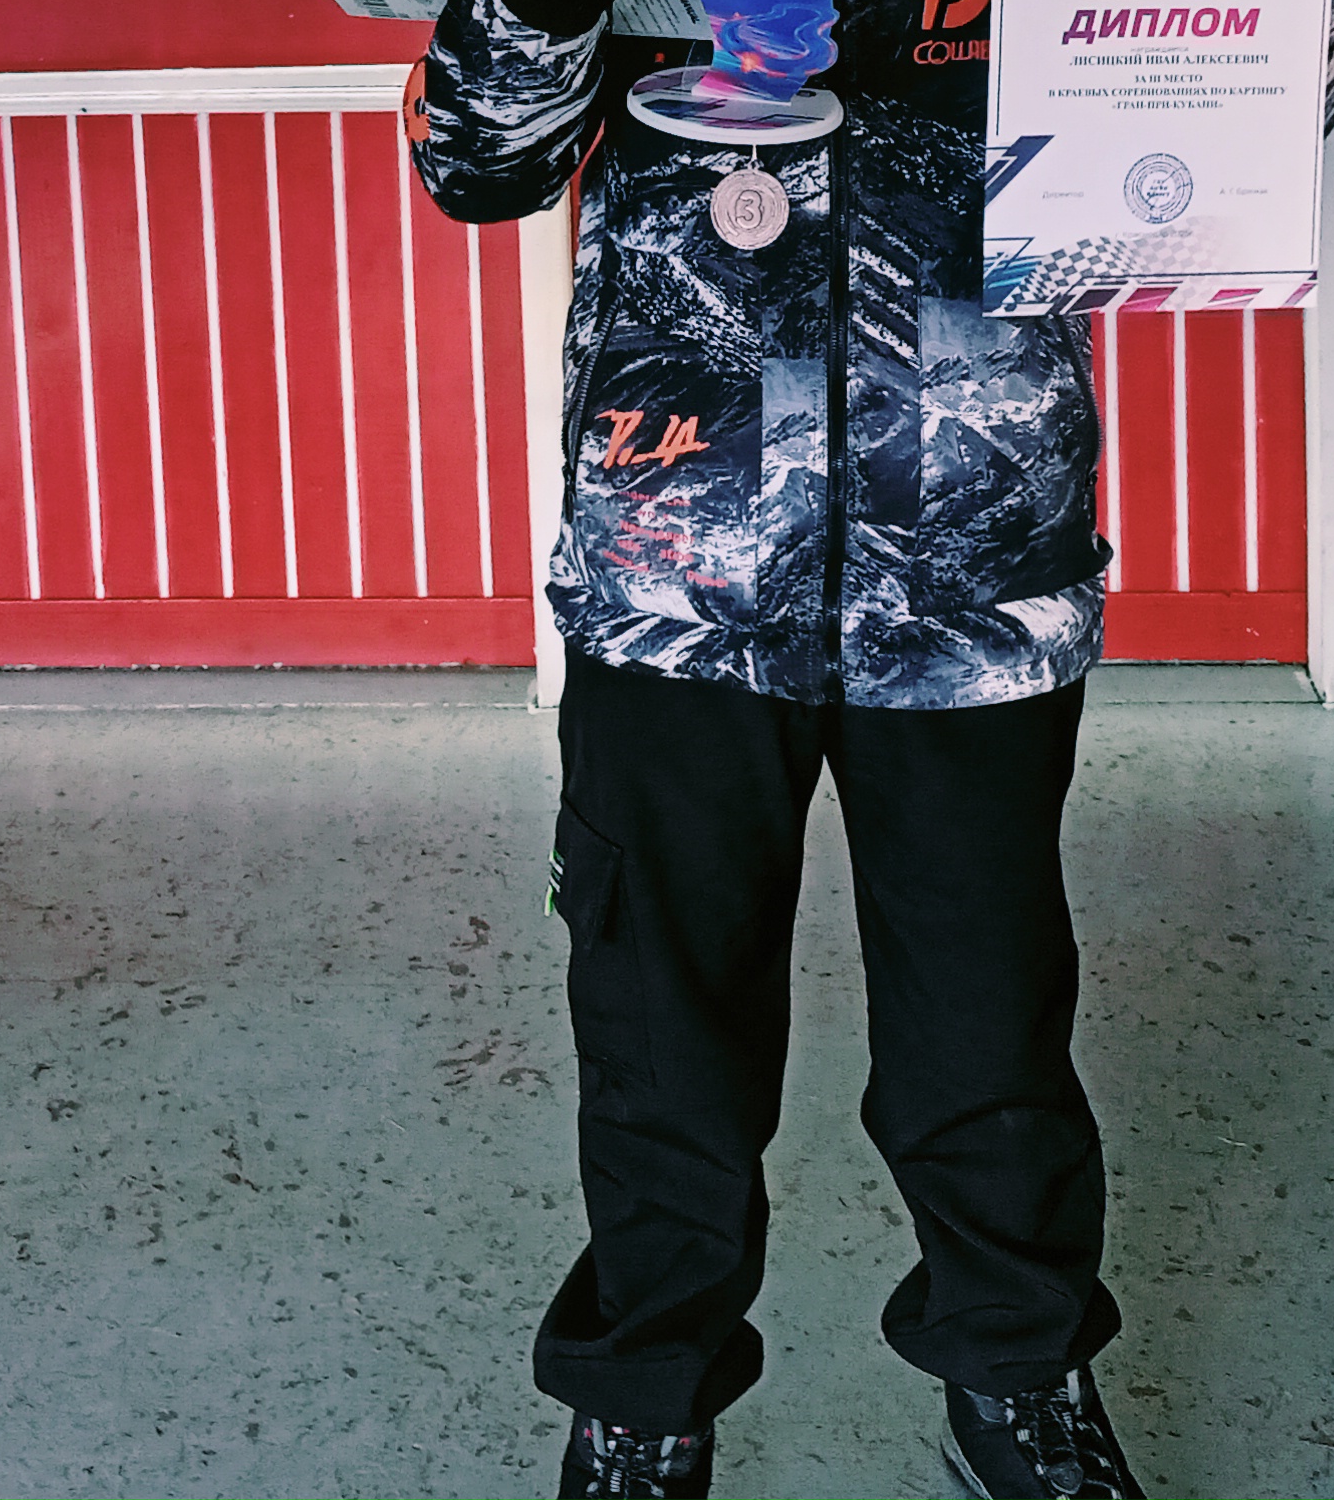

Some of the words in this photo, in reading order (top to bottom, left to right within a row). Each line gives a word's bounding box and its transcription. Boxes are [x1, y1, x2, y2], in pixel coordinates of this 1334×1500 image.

[1061, 7, 1261, 45] ДИПЛОМ
[1069, 53, 1143, 66] ЛИСИЦКИЙ
[1146, 55, 1180, 65] ИВАН
[1183, 55, 1269, 65] АЛЕКСЕЕВИЧ
[1164, 74, 1203, 83] МЕСТО
[1058, 88, 1109, 97] КРАЕВЫХ
[1111, 88, 1208, 97] СОРЕВНОВАНИЯХ
[1229, 86, 1287, 96] КАРТИНГУ
[737, 187, 764, 230] 3
